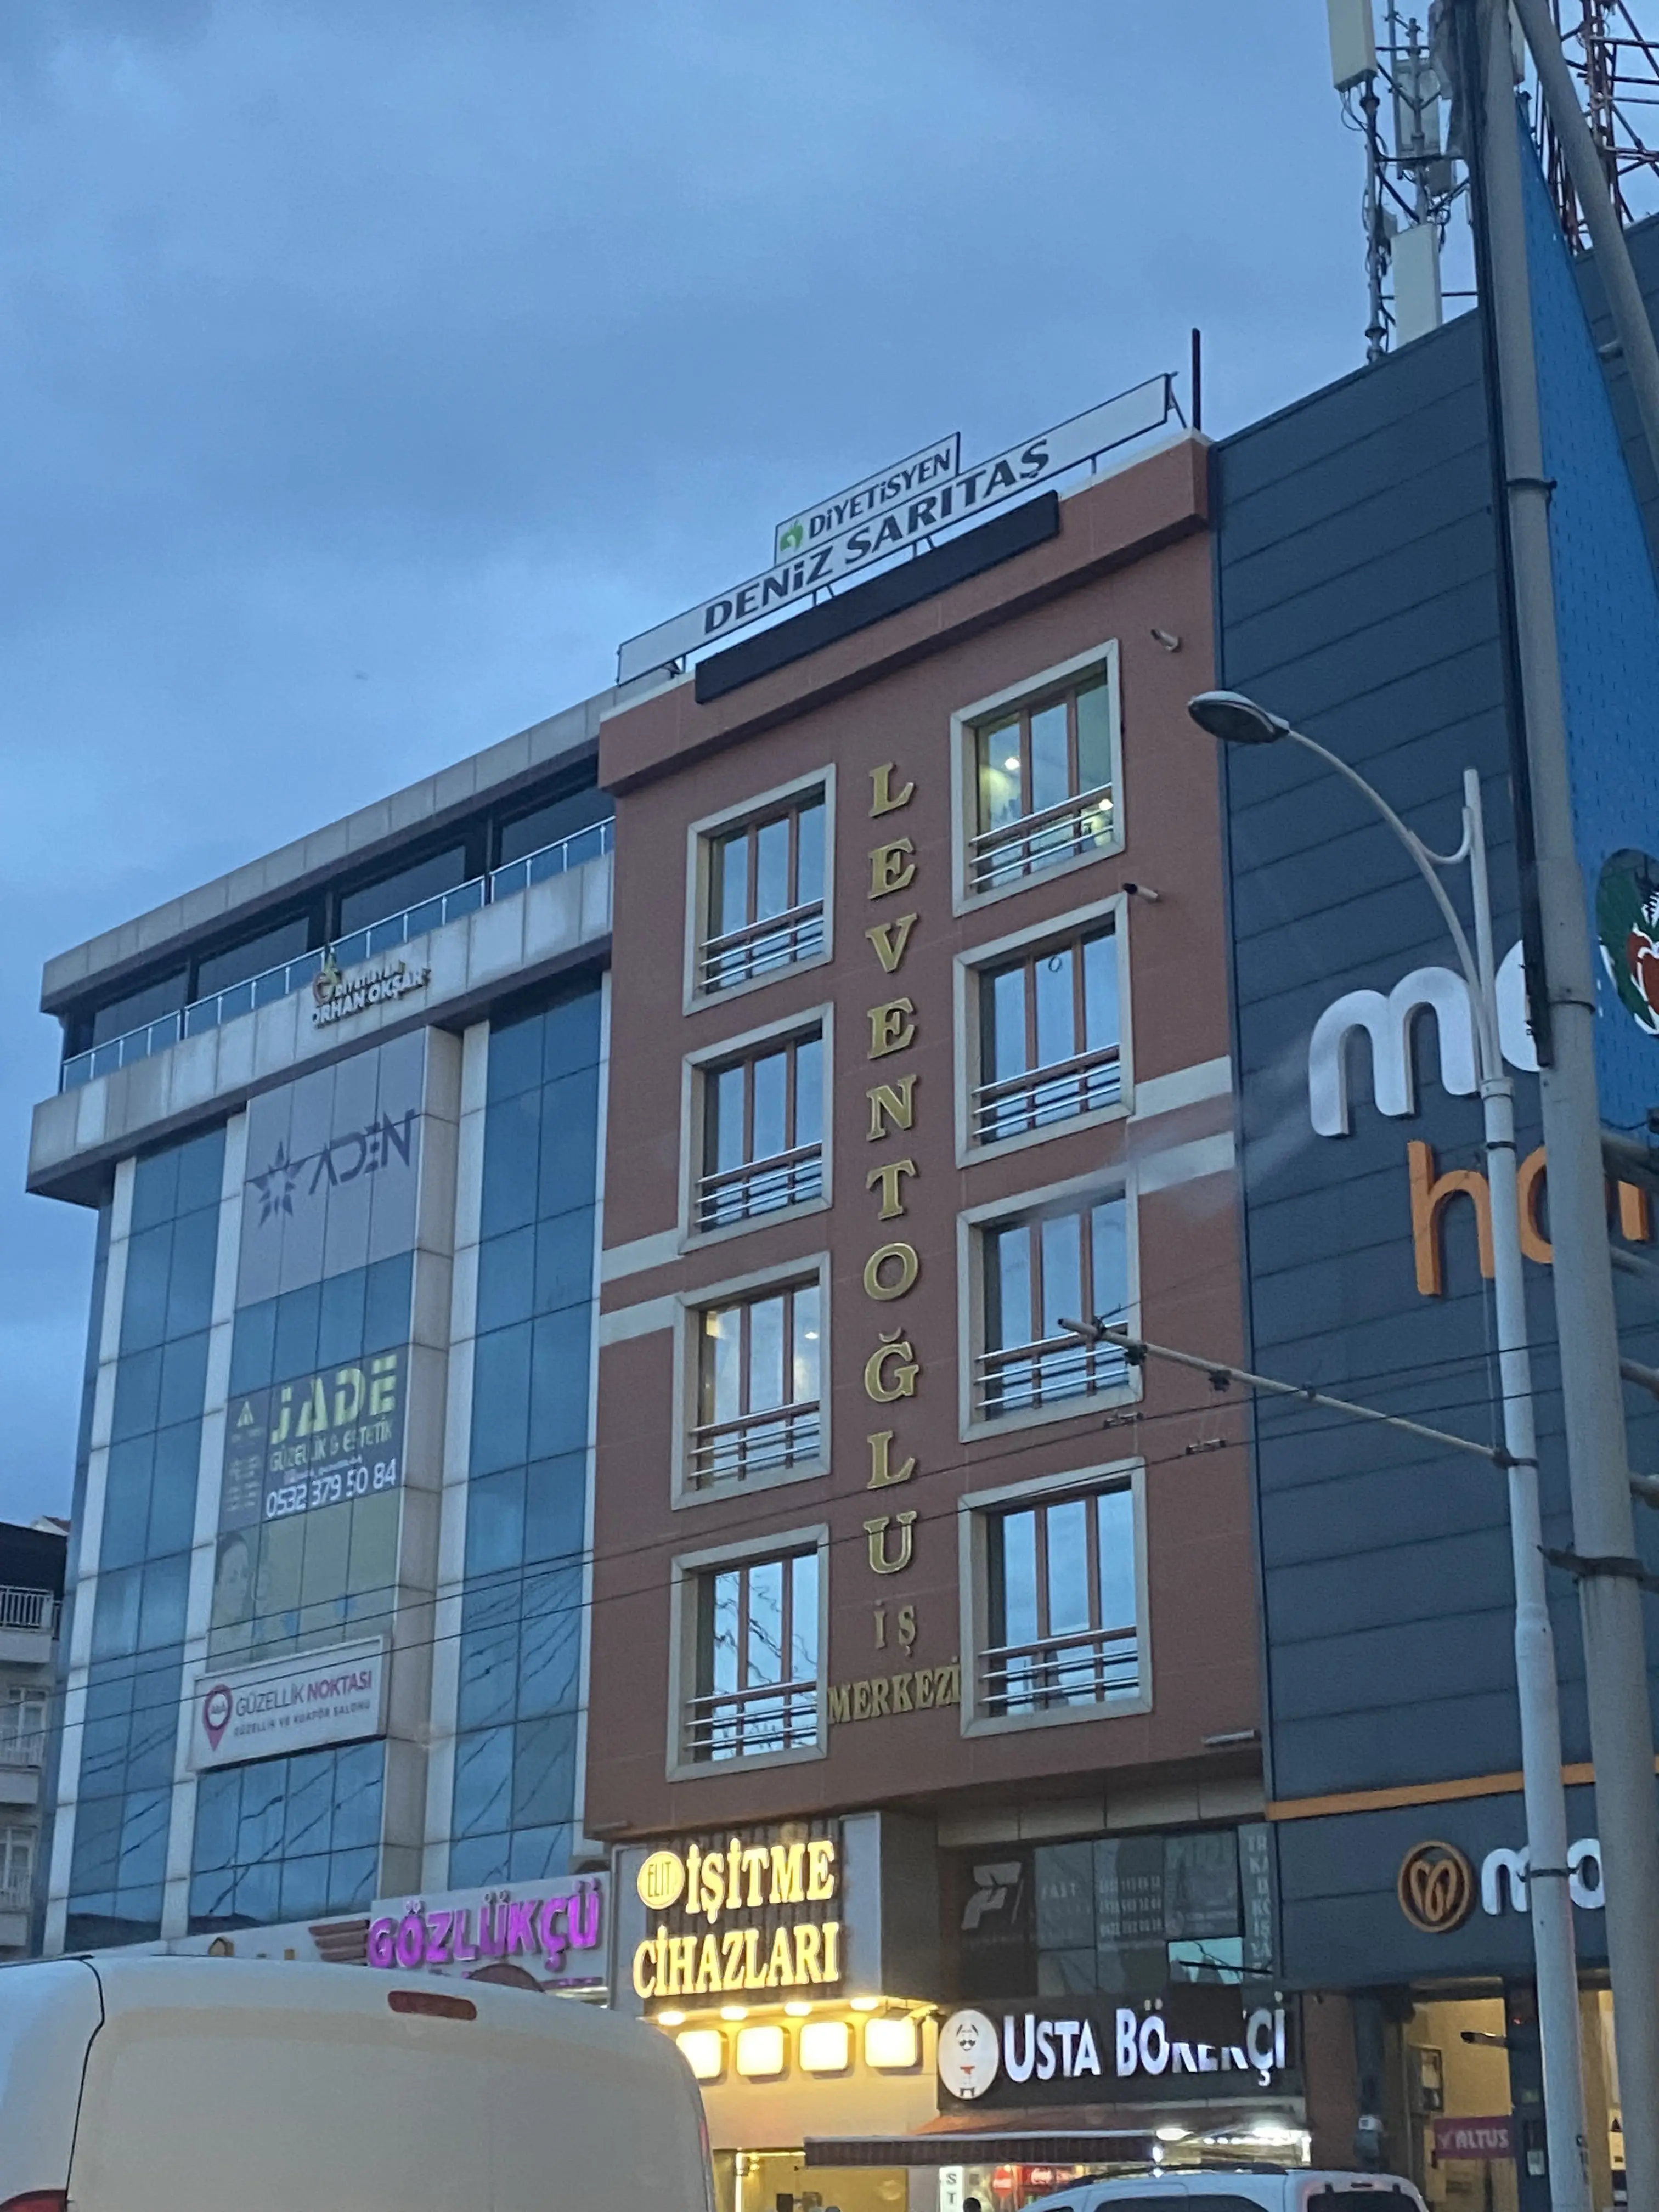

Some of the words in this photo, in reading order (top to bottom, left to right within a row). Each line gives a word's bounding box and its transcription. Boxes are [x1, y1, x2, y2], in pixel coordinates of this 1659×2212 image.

[311, 1474, 342, 1505] 379
[373, 1458, 396, 1490] 84
[306, 1670, 372, 1702] NOKTASI
[827, 1656, 961, 1725] MERKEZİ
[685, 1838, 834, 1923] İŞİTME
[366, 1876, 601, 1972] GÖZLÜKÇÜ
[633, 1922, 840, 1999] CİHAZLARI
[1003, 2013, 1101, 2083] USTA
